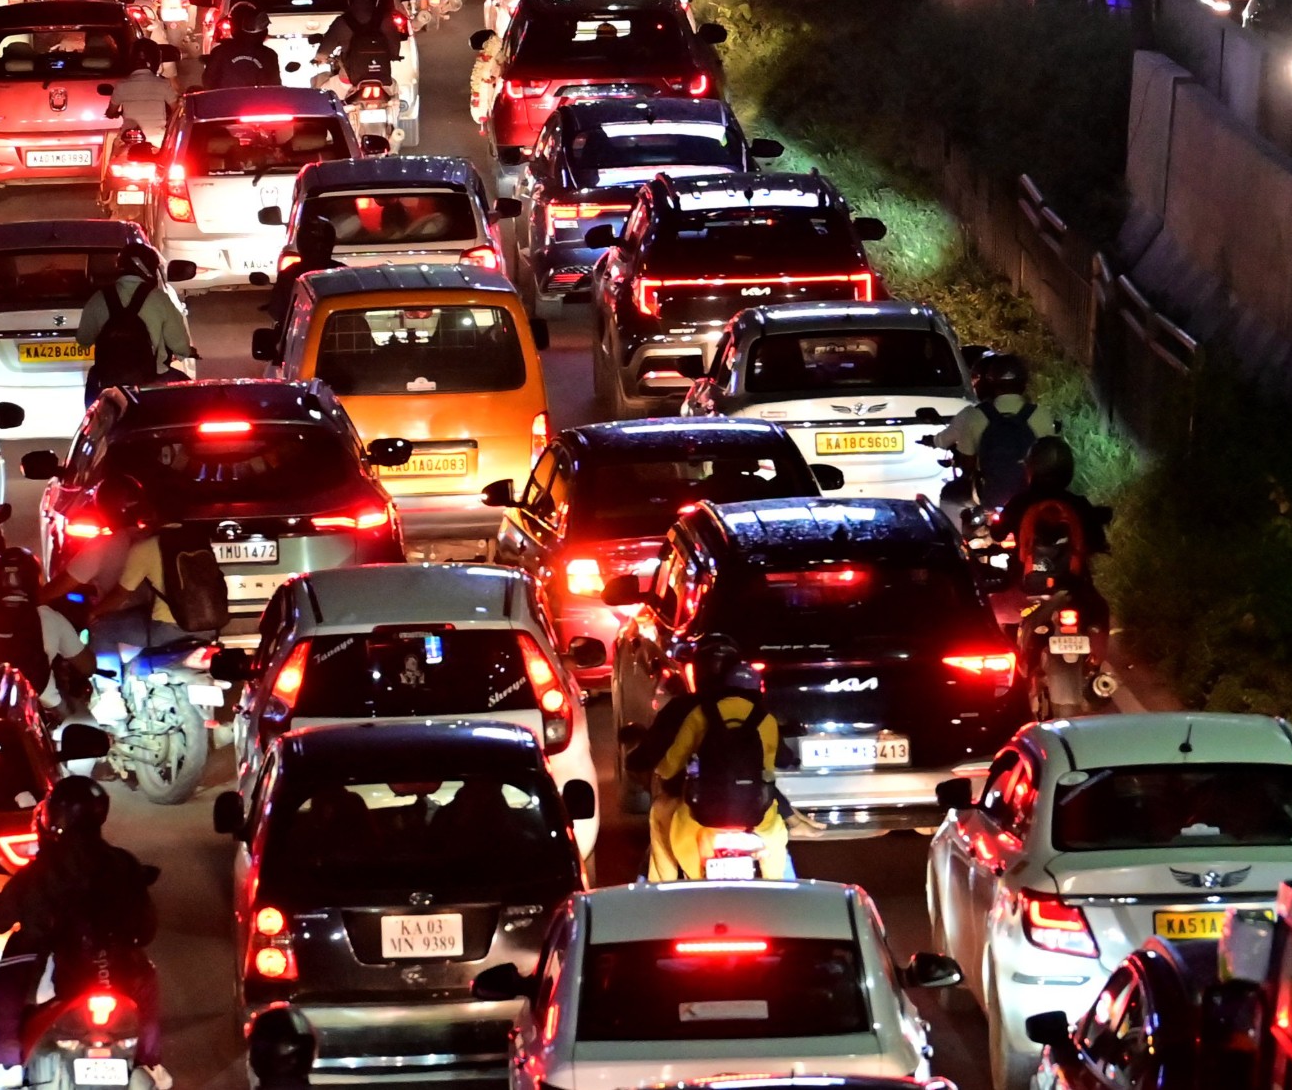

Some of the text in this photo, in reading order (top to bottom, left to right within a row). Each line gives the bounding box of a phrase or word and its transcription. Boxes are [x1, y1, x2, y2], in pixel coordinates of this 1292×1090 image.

[219, 544, 276, 559] 1MU1472
[401, 920, 444, 936] KA 03
[390, 936, 455, 953] MN 9389
